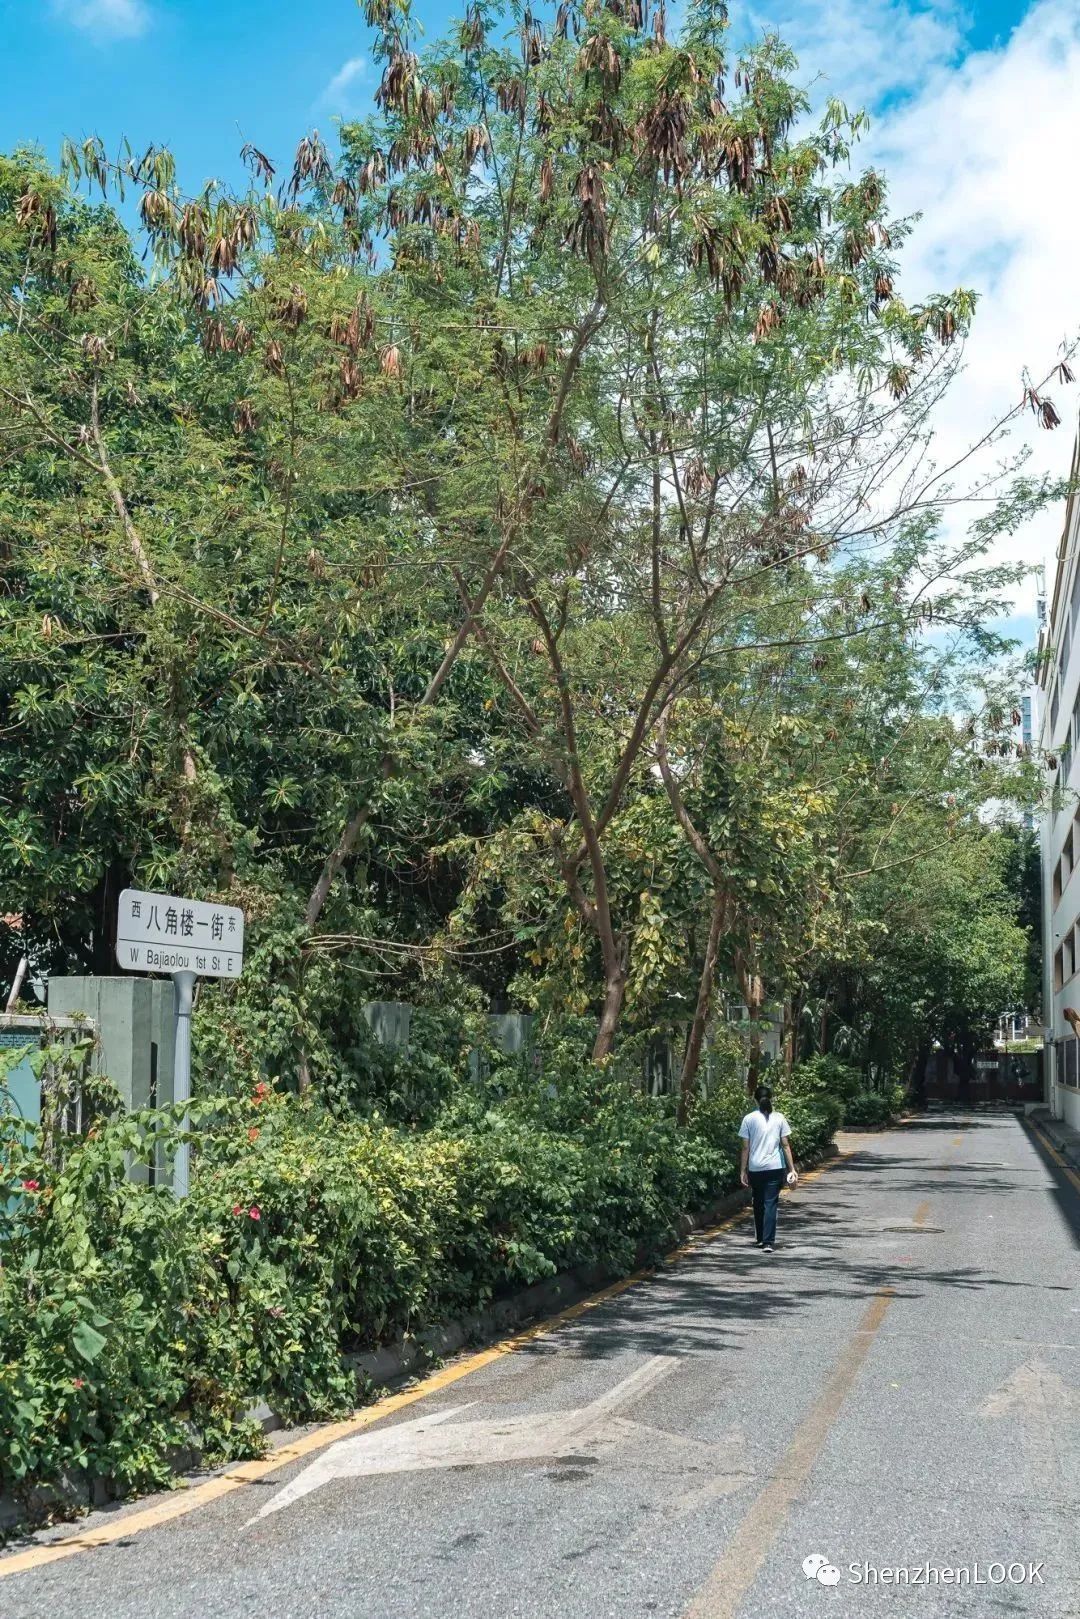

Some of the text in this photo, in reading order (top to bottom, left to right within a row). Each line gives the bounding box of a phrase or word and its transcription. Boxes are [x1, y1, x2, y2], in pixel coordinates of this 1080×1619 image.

[131, 900, 236, 941] 西 八角楼一街 东
[130, 948, 233, 971] W Bajiaolou 1st St E
